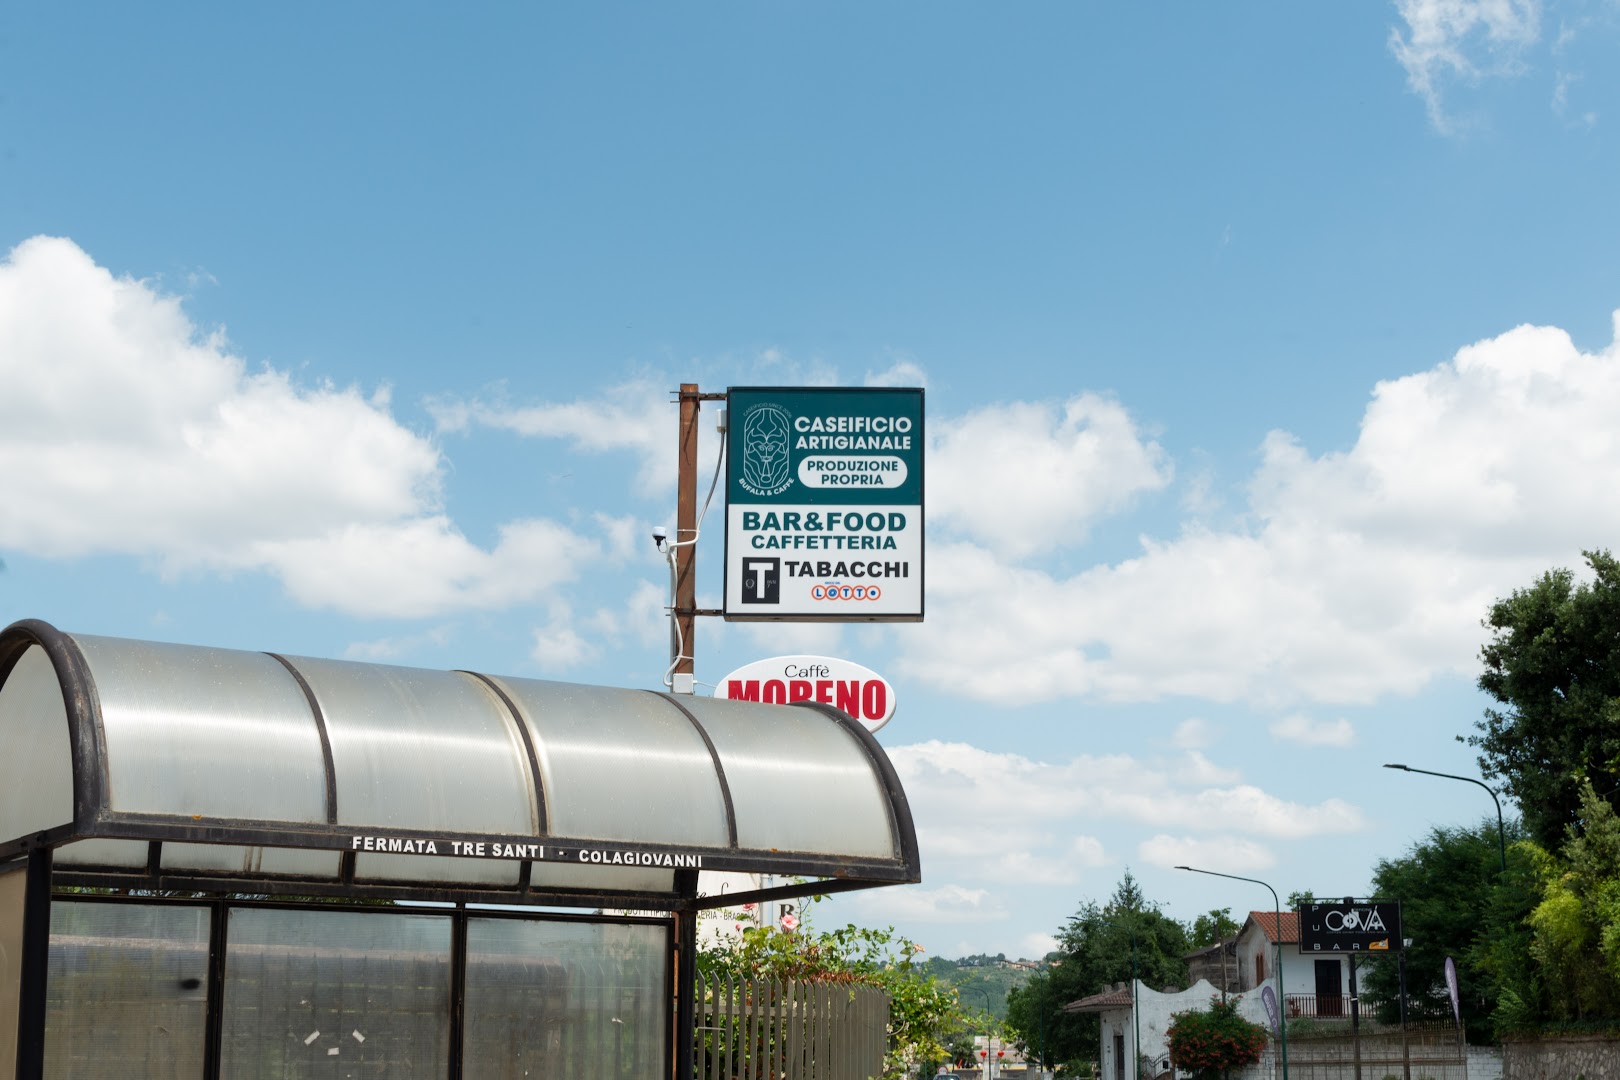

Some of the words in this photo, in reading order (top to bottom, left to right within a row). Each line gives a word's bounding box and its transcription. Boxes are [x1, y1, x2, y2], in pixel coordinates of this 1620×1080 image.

[794, 416, 912, 433] CASEIFICIO
[795, 435, 911, 450] ARTIGIANALE
[807, 460, 898, 472] PRODUZIONE
[738, 477, 765, 496] BUFALA
[821, 474, 884, 485] PROPRIA
[742, 511, 907, 532] BAR&FOOD
[751, 534, 897, 550] CAFFETTERIA
[784, 561, 909, 578] TABACCHI
[749, 562, 774, 599] T
[811, 585, 881, 601] LOTTO
[784, 664, 830, 678] Caffè
[728, 679, 886, 720] MORENO
[352, 836, 438, 855] FERMATA
[451, 841, 486, 857] TRE
[491, 842, 544, 859] SANTI
[578, 849, 702, 869] COLAGIOVANNI
